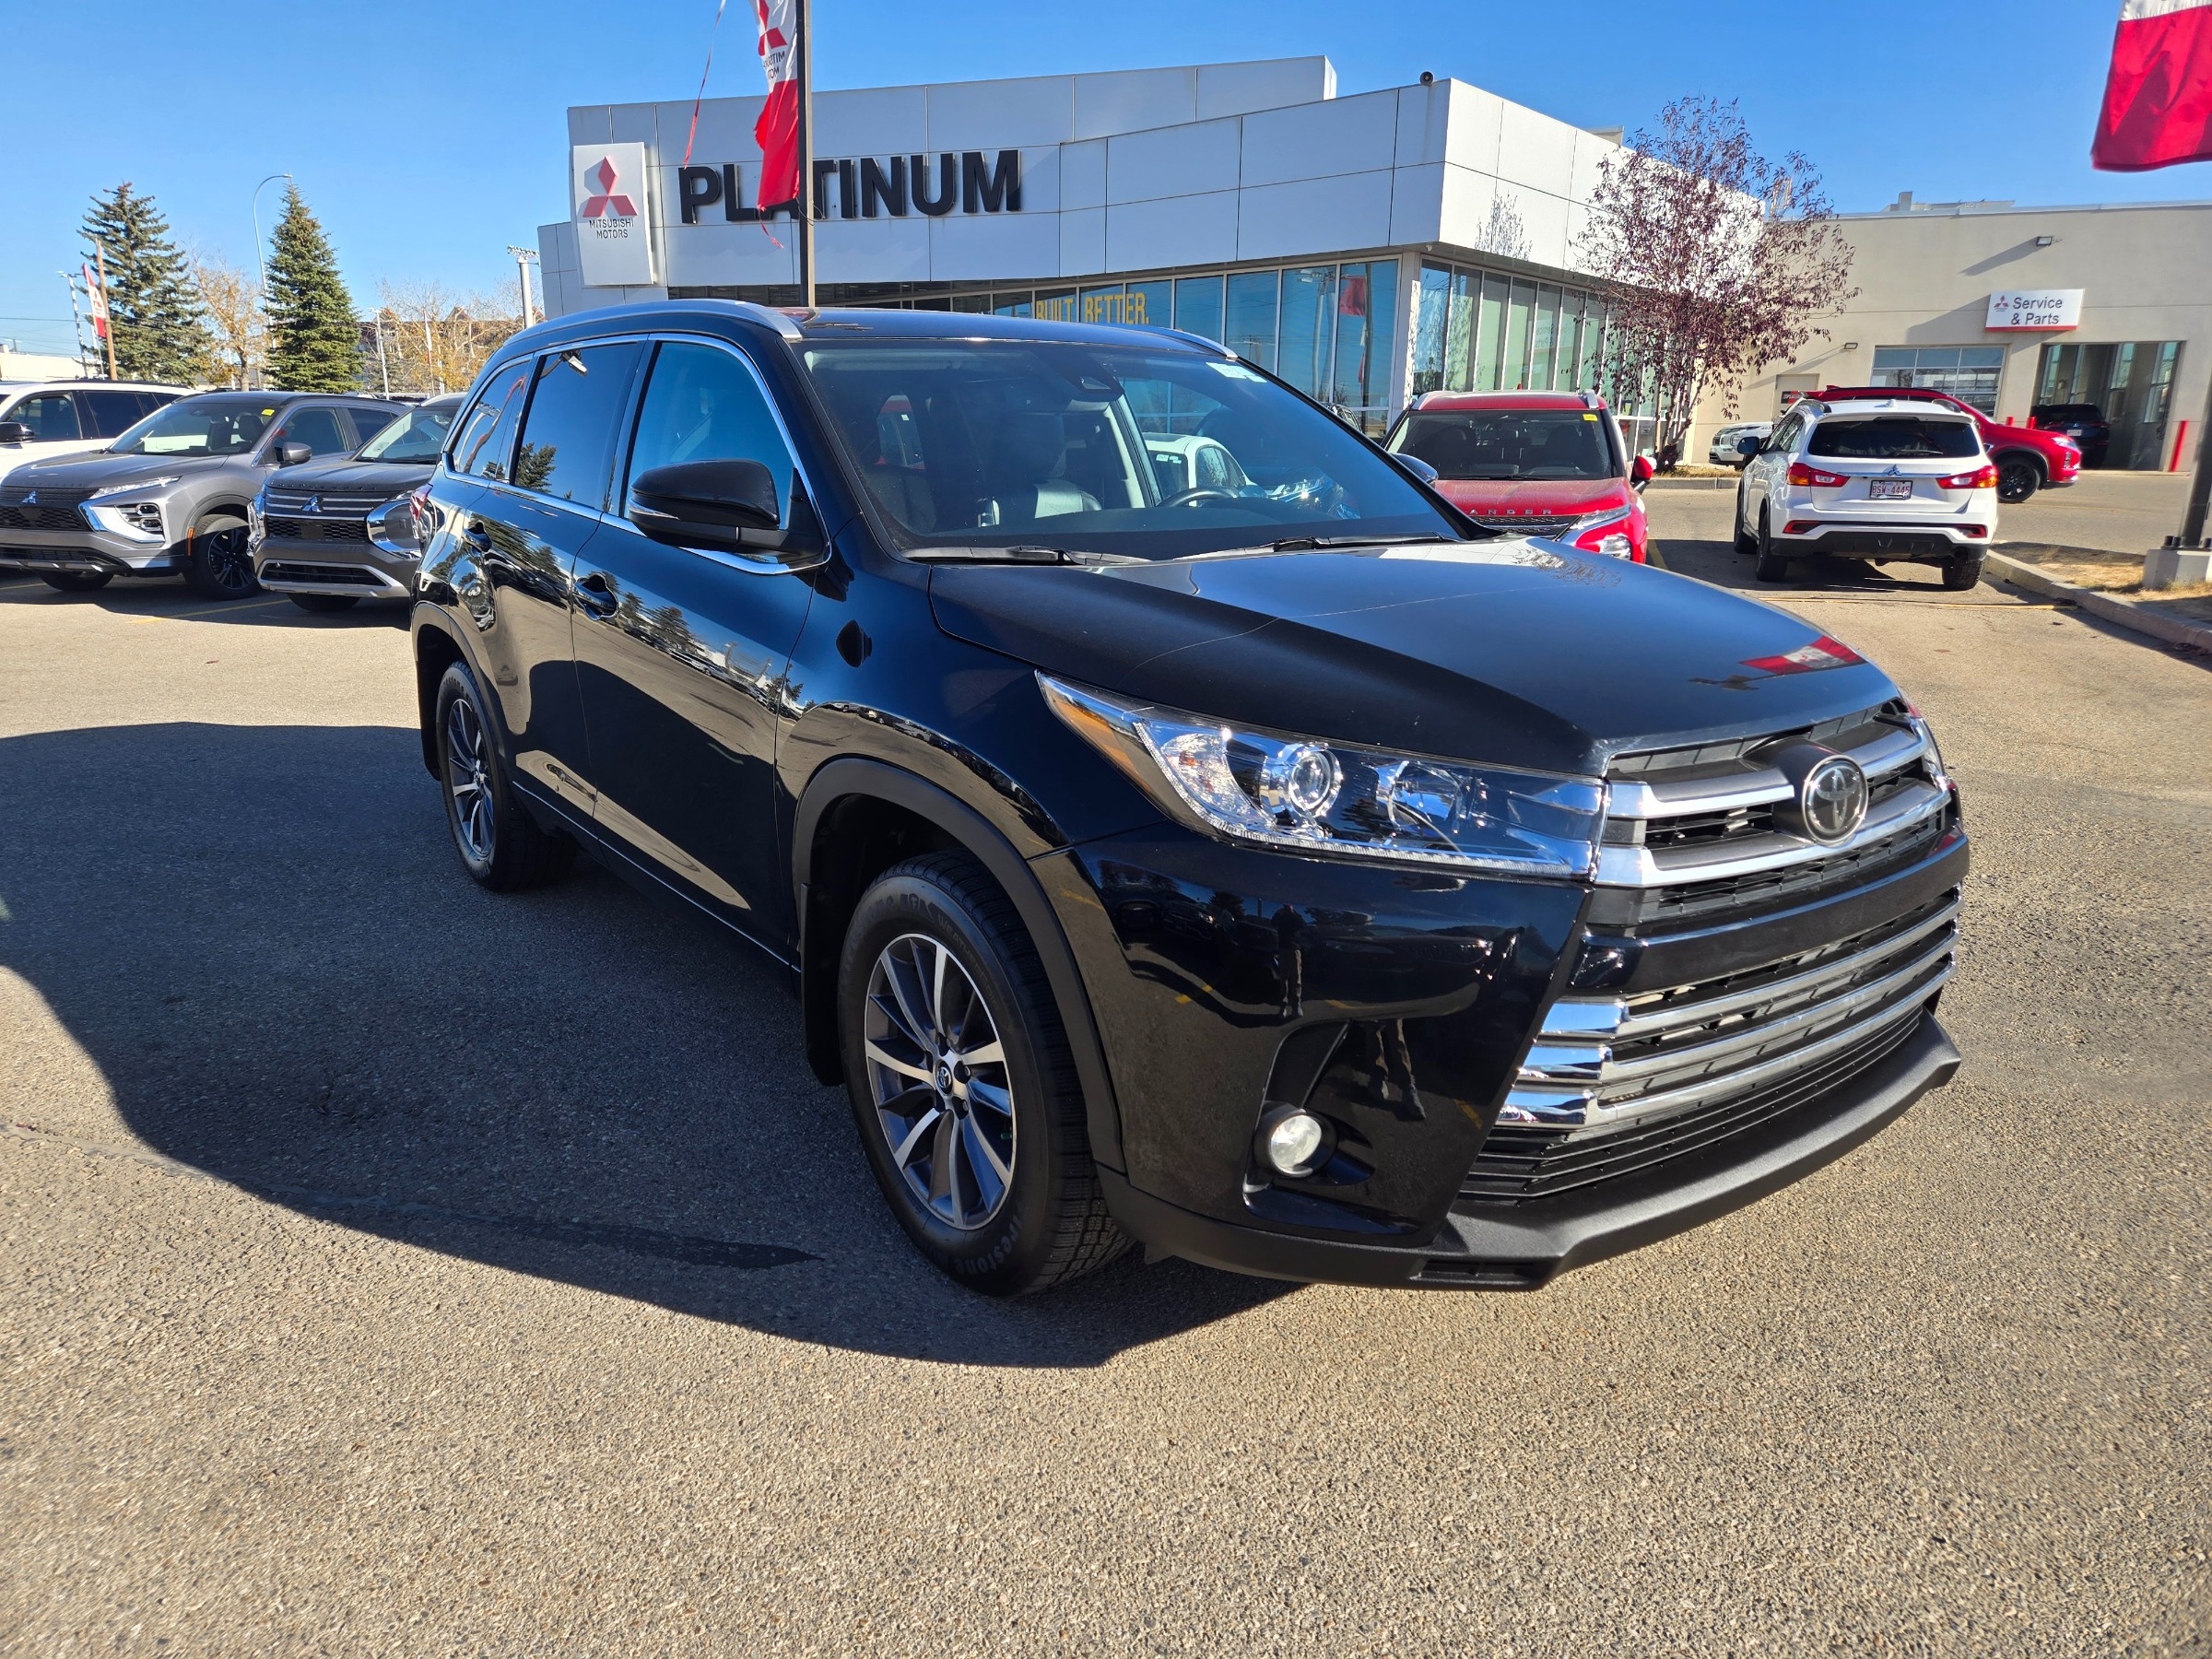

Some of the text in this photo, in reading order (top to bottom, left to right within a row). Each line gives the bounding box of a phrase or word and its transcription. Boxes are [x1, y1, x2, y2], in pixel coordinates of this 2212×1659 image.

[678, 149, 1020, 224] PLTINUM
[589, 218, 634, 229] MITSUBISHI
[596, 229, 629, 239] MOTORS
[2012, 296, 2063, 310] Service
[2011, 312, 2059, 324] & Parts
